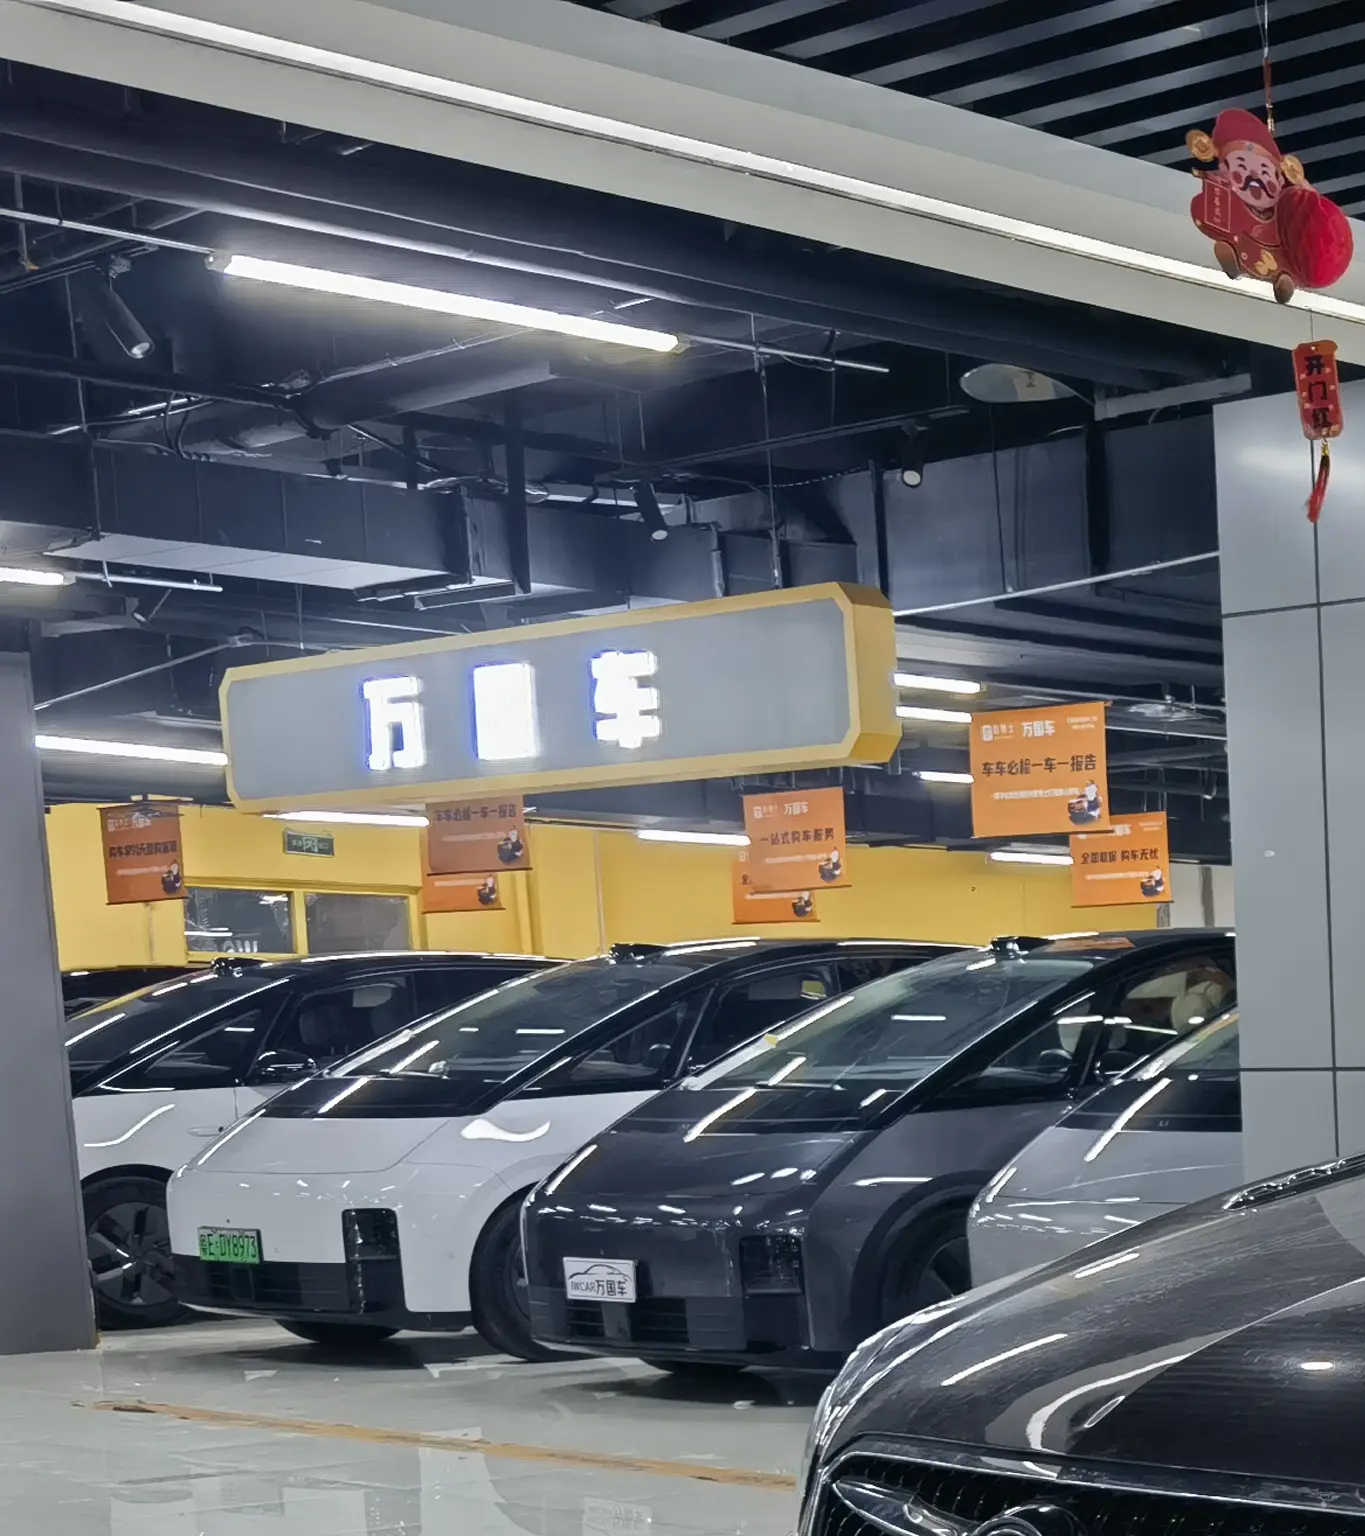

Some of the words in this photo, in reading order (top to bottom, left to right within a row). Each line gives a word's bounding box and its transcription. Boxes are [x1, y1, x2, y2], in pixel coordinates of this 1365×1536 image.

[1021, 720, 1056, 738] 万国车
[982, 753, 1097, 777] 车车必检一车一报告
